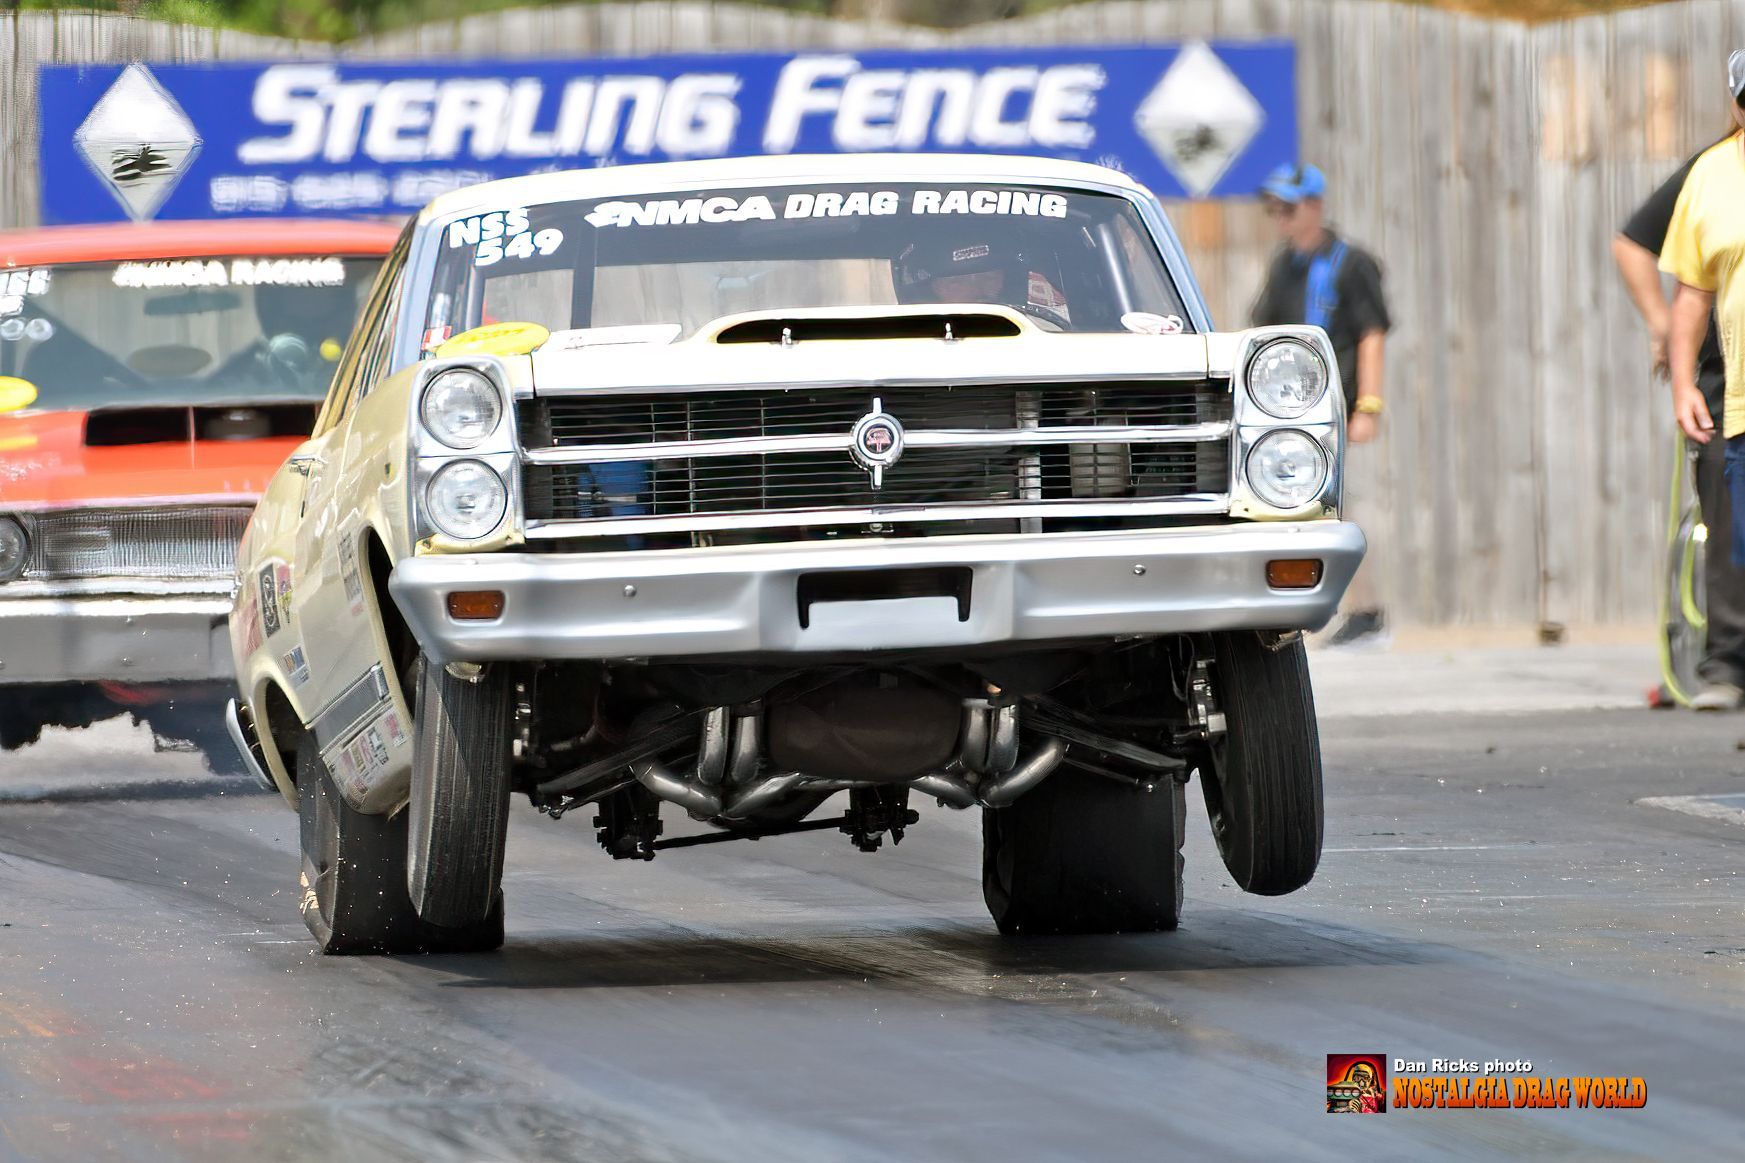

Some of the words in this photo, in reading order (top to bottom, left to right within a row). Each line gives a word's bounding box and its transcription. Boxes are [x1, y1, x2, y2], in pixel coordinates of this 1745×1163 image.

[784, 190, 899, 219] DRAG
[911, 189, 1068, 218] RACING
[449, 207, 530, 248] NSS
[475, 228, 564, 266] 549
